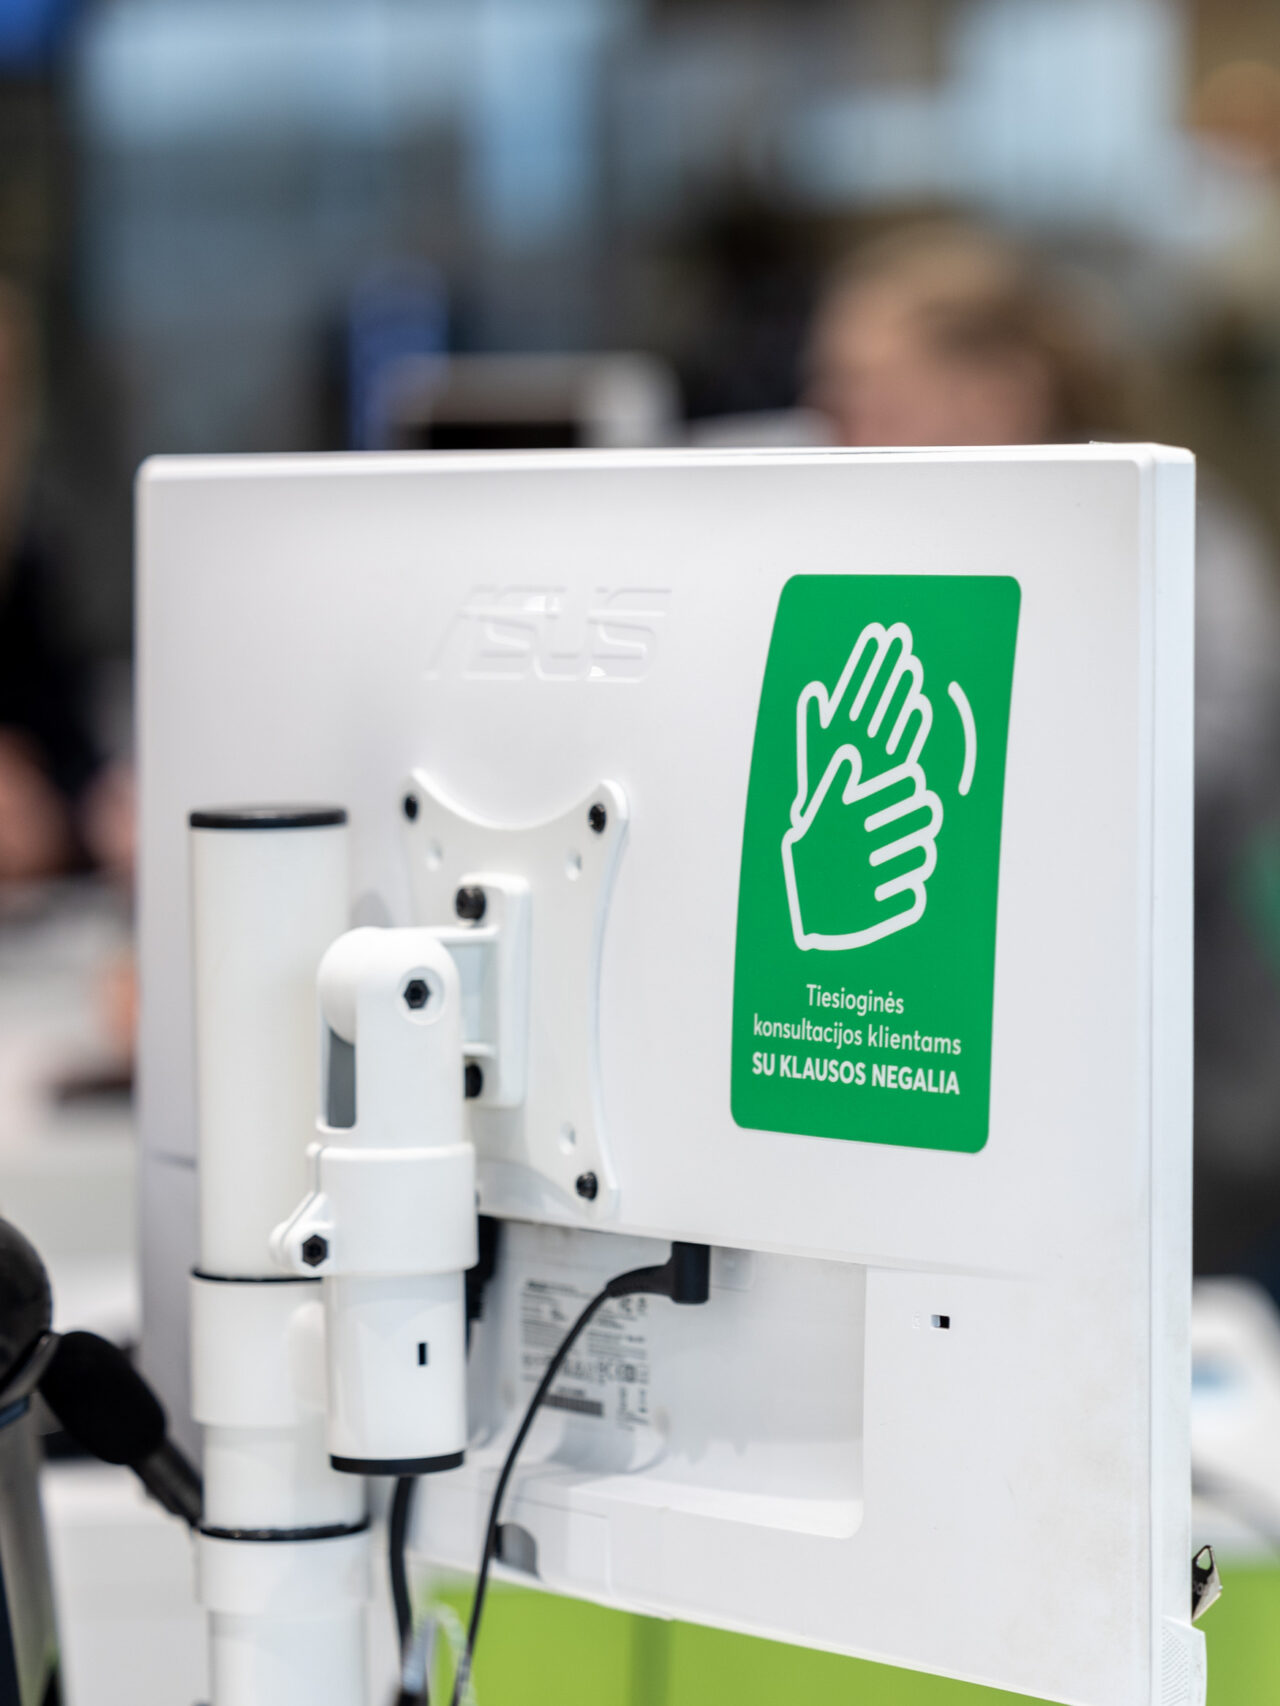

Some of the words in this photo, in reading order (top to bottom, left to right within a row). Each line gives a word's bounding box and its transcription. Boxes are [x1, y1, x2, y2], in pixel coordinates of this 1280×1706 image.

[421, 583, 673, 684] ASUS
[806, 983, 905, 1017] Tiesioginės
[753, 1012, 863, 1050] konsultacijos
[867, 1023, 962, 1056] klientams
[752, 1051, 776, 1076] SU
[779, 1053, 867, 1086] KLAUSOS
[871, 1063, 961, 1095] NEGALIA
